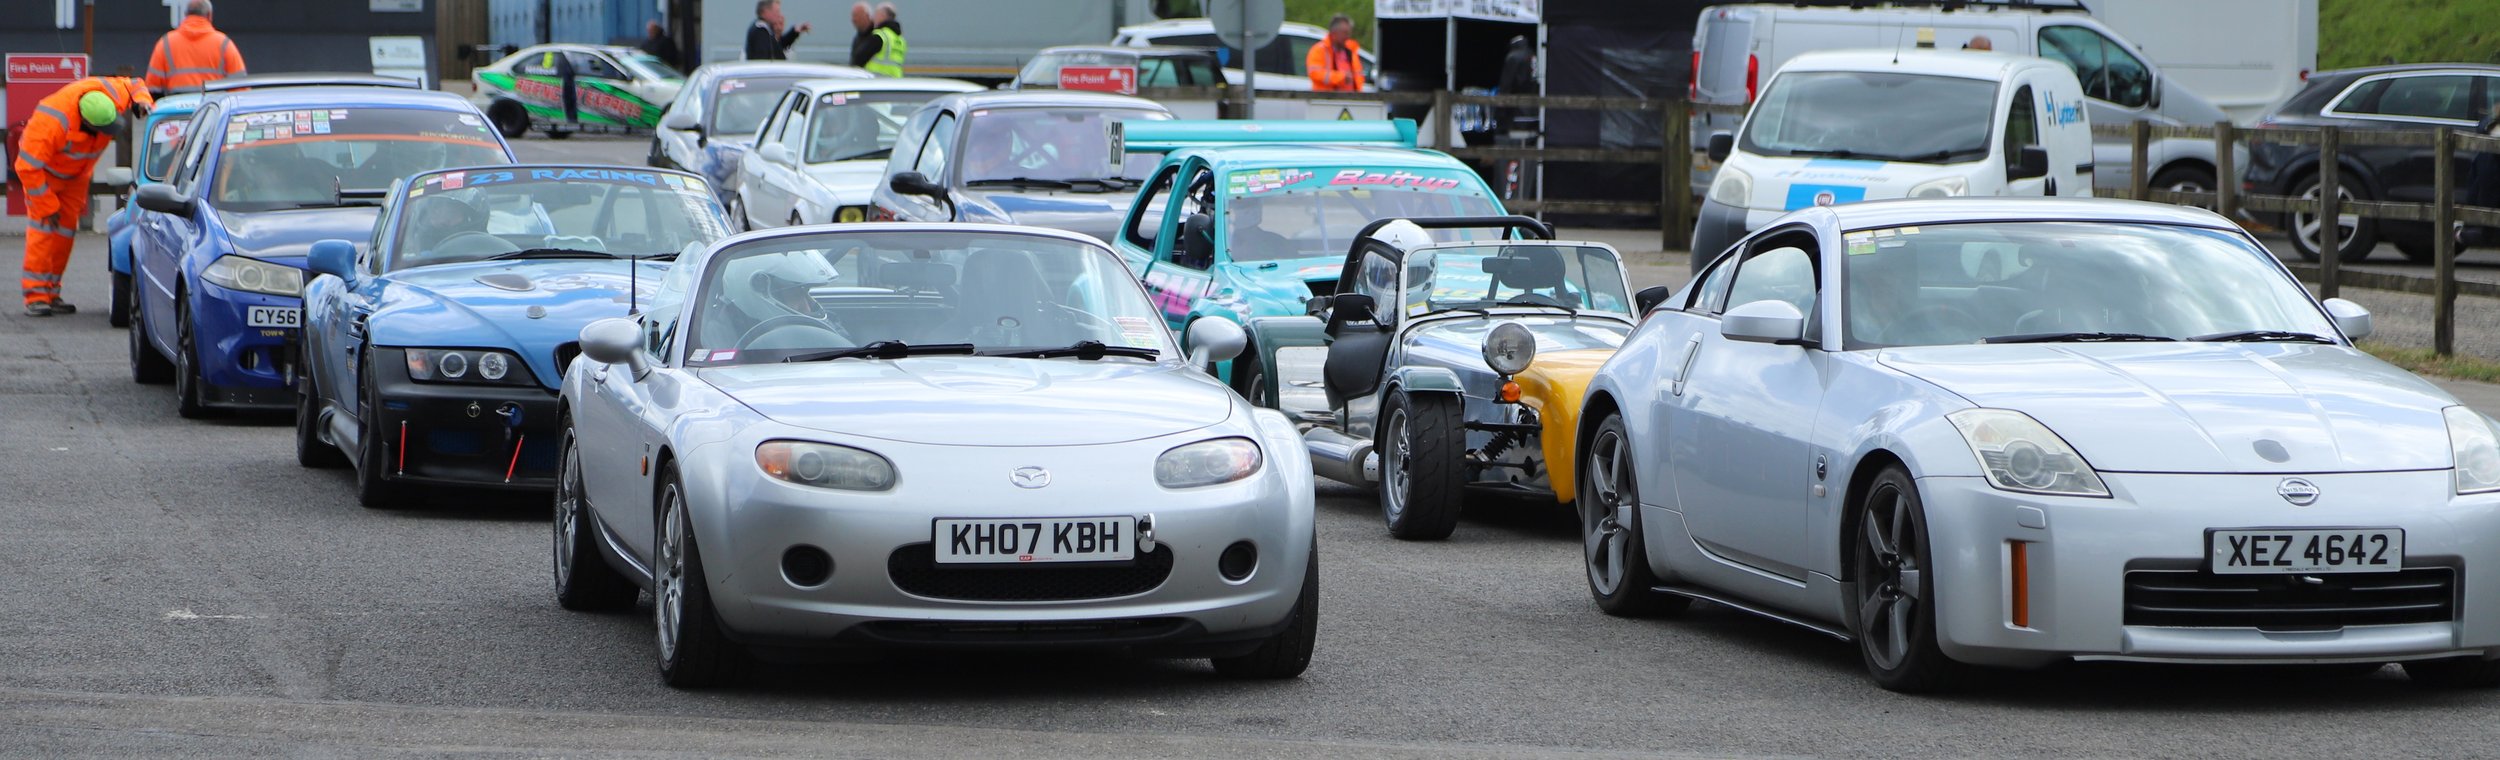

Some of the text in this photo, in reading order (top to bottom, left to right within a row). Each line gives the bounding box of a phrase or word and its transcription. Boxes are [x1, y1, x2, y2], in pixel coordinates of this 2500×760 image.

[10, 62, 55, 73] Fire Point
[1062, 73, 1104, 85] Fire Point
[469, 171, 514, 185] Z3
[531, 169, 657, 186] RACING
[254, 309, 297, 325] CY56
[2283, 486, 2316, 494] NISSAN
[951, 521, 1119, 555] KH07 KBH
[2228, 534, 2388, 567] XEZ 4642
